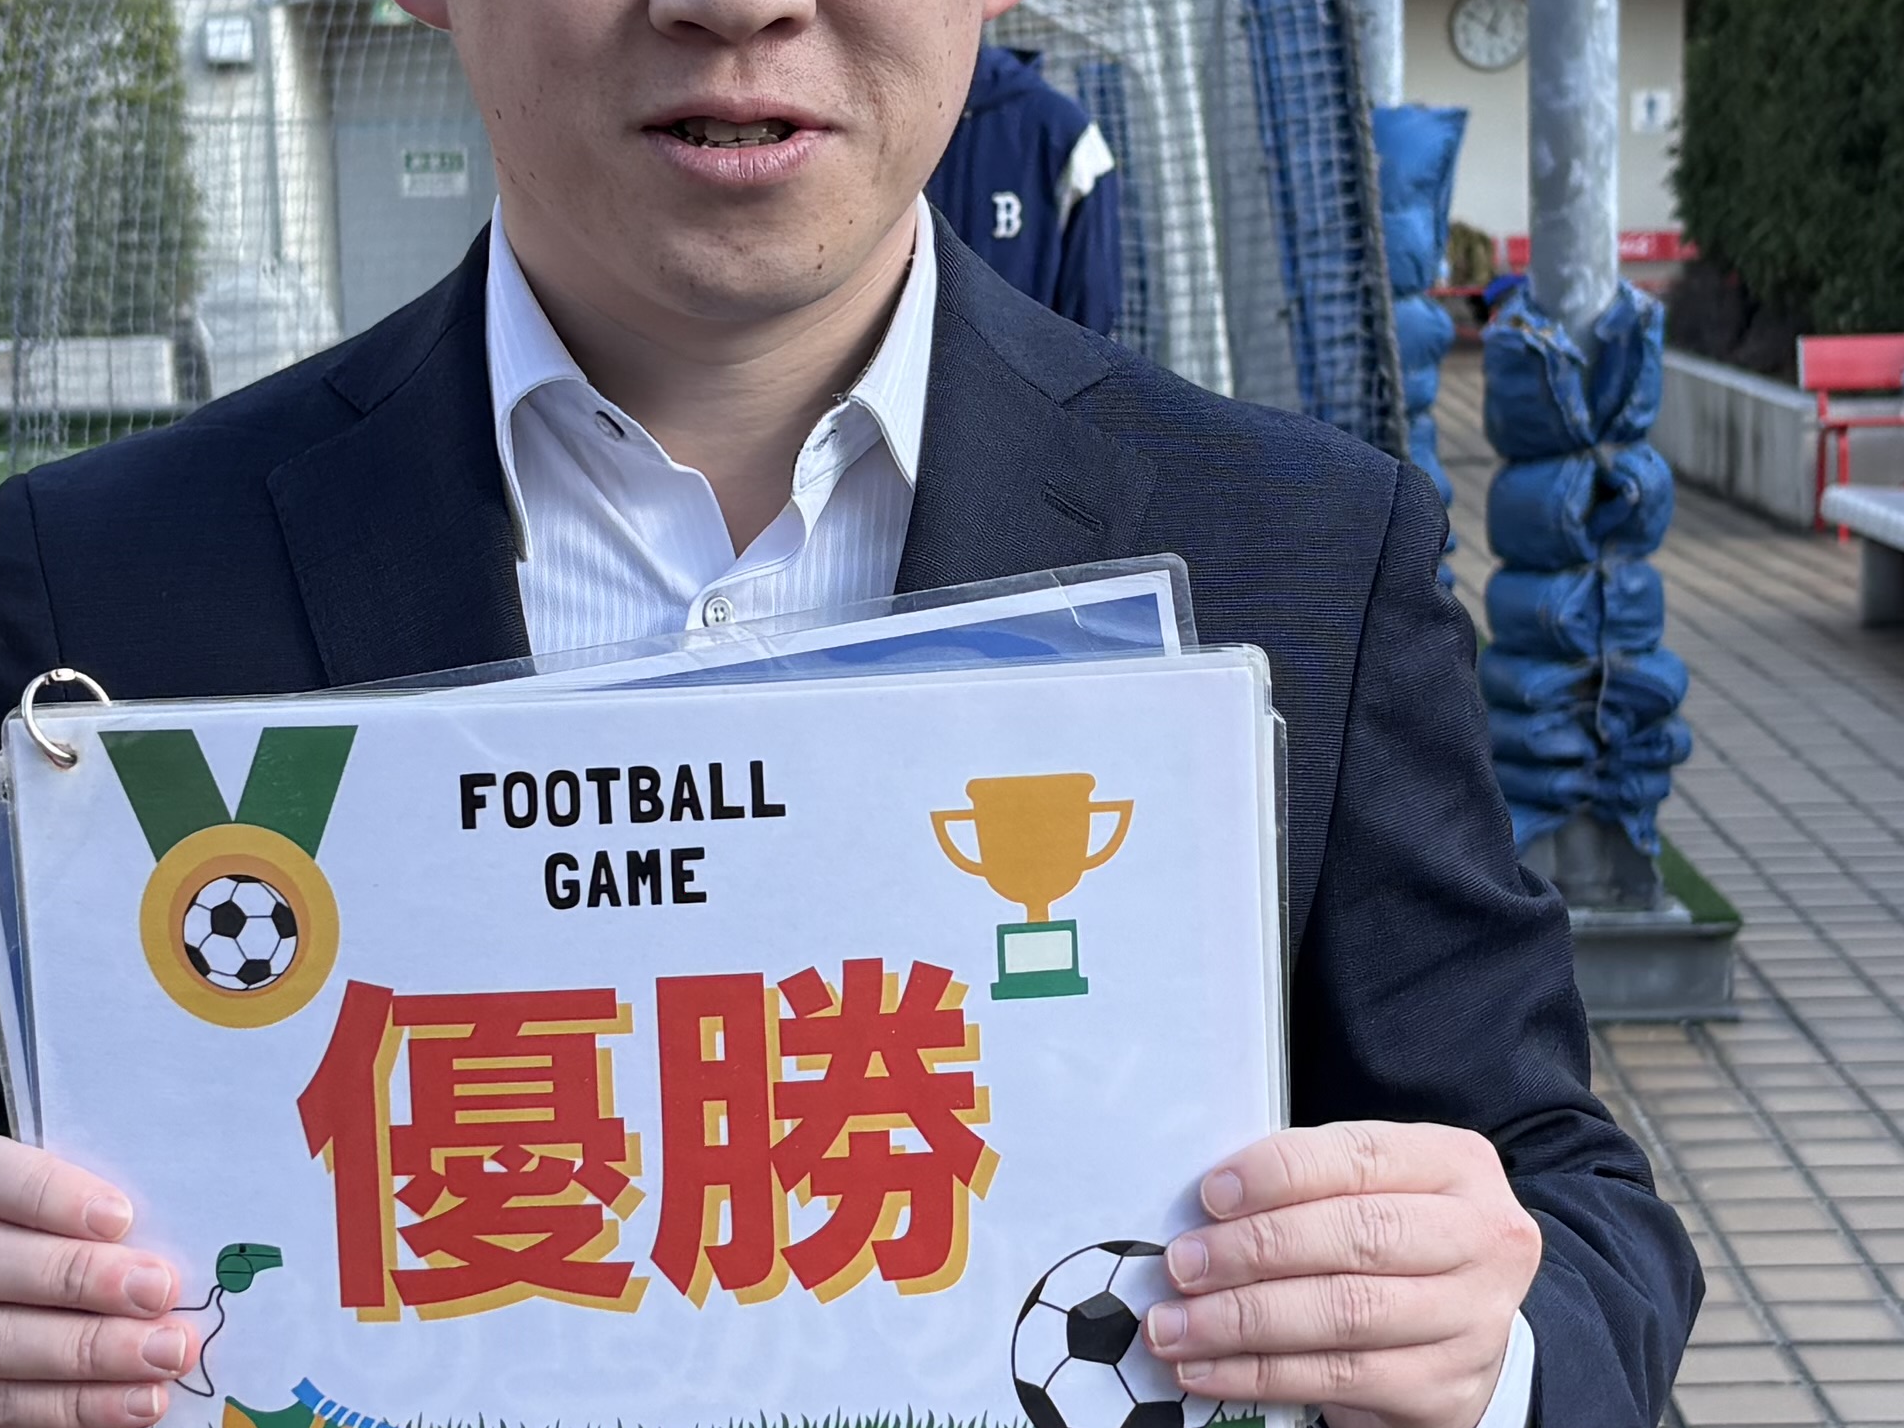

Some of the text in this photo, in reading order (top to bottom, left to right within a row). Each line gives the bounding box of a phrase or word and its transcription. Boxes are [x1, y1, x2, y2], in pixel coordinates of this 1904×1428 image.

[992, 190, 1023, 239] B
[459, 760, 786, 830] FOOTBALL
[544, 846, 707, 910] GAME
[298, 957, 998, 1324] 優勝
